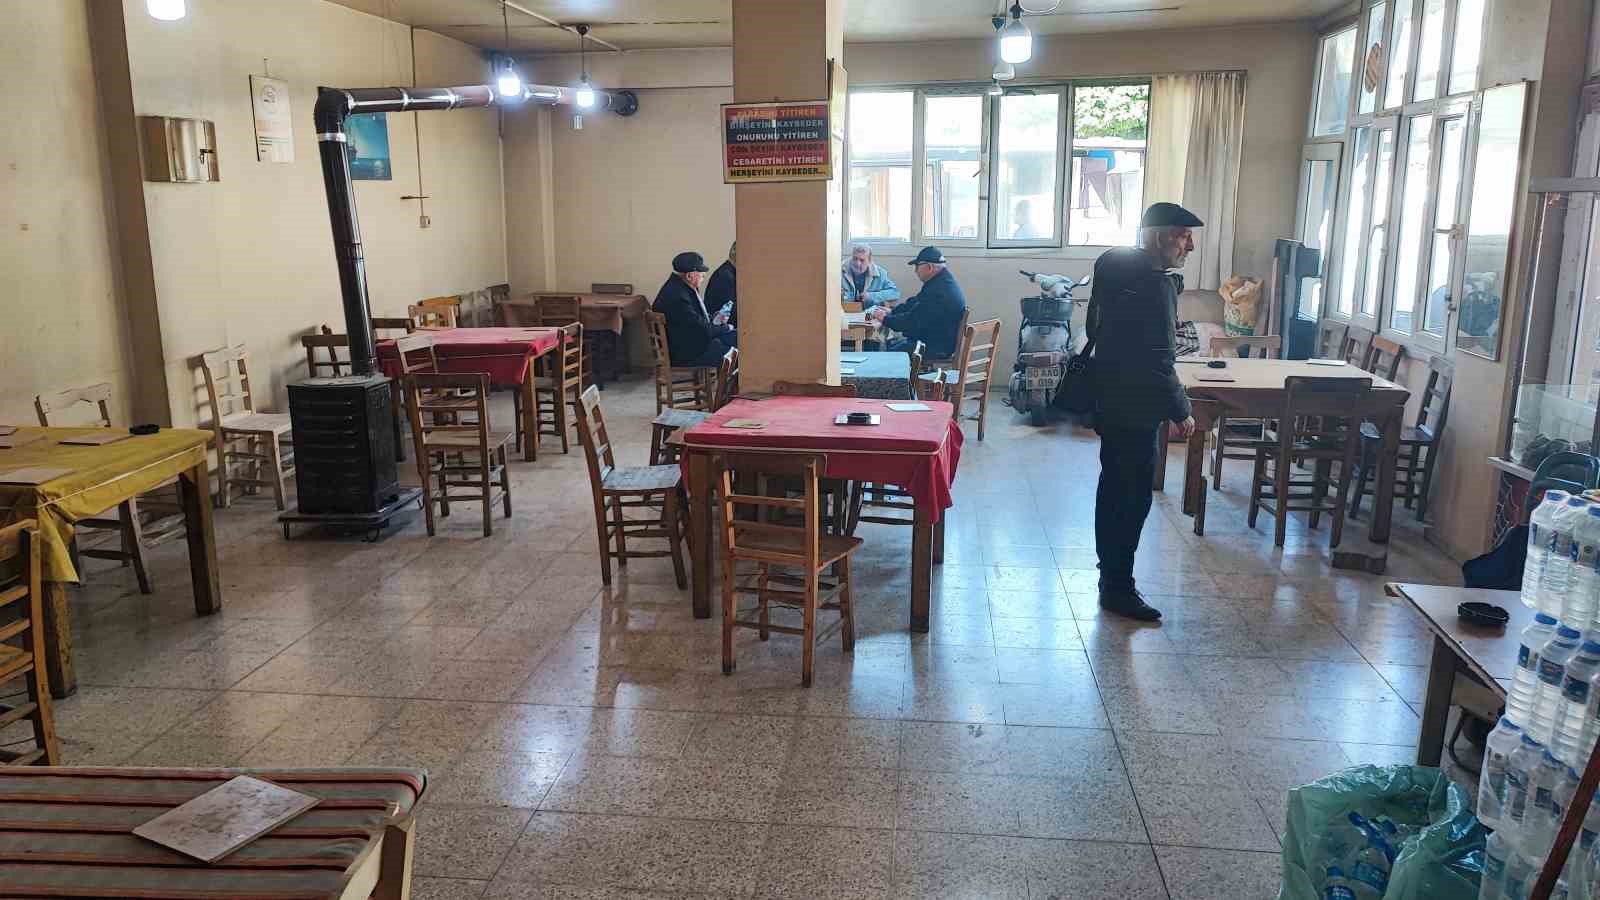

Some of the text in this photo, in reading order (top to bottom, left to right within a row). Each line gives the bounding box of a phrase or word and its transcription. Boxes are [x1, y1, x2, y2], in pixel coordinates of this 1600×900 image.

[737, 131, 818, 141] ONURUNU YİTİREN
[733, 155, 823, 166] CESARETİNİ YİTİREN
[730, 168, 774, 179] HERŞEYİNİ
